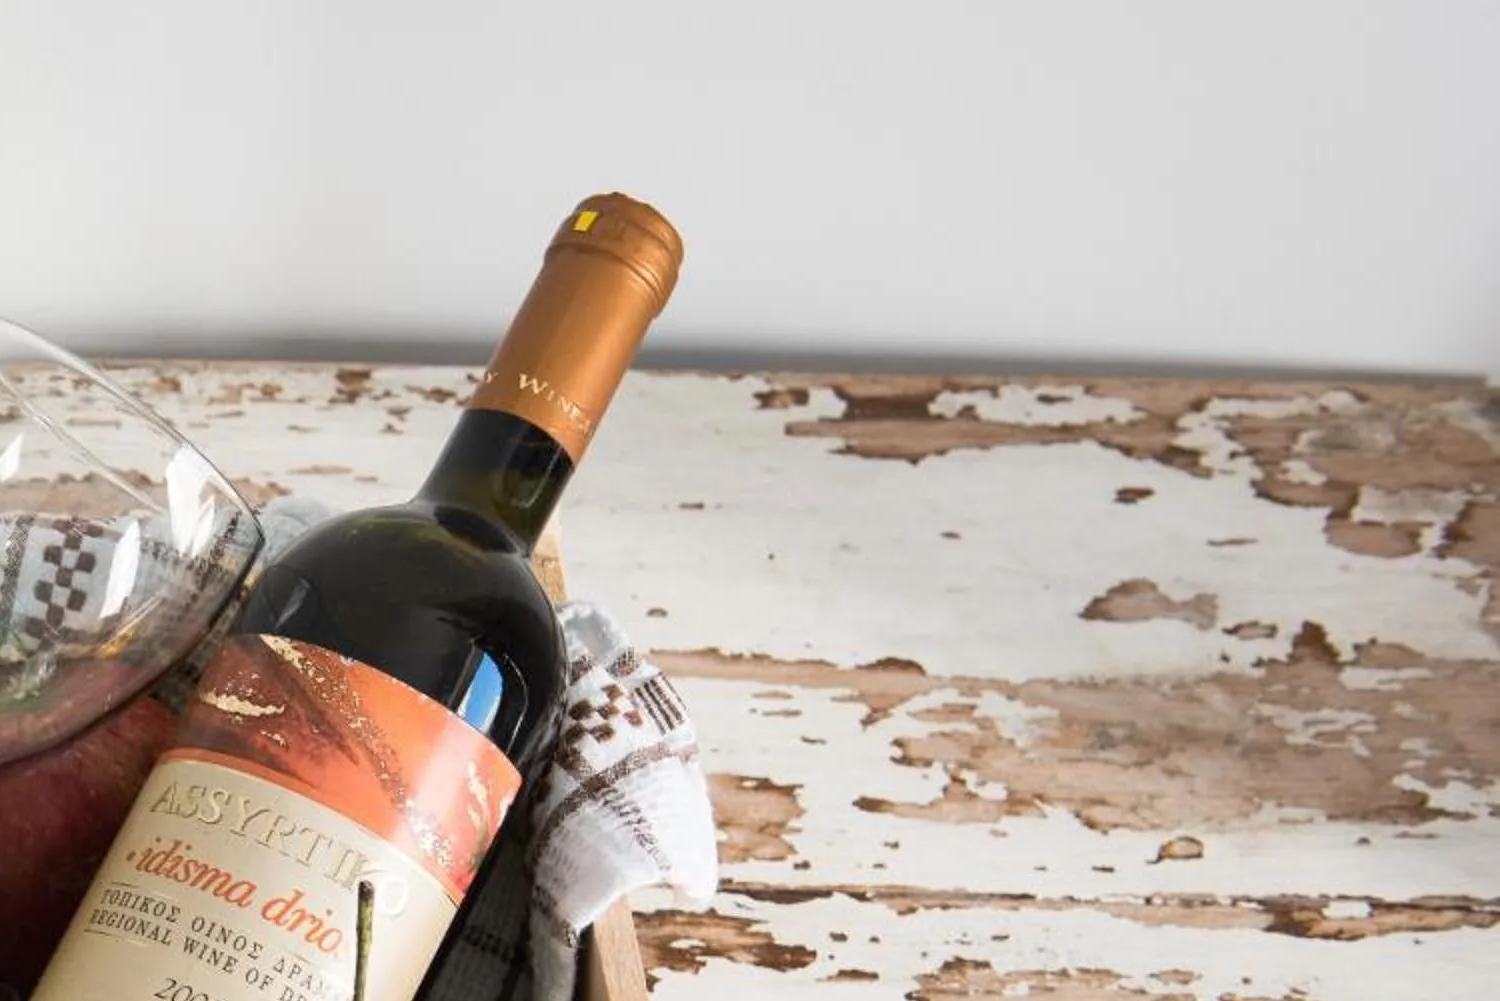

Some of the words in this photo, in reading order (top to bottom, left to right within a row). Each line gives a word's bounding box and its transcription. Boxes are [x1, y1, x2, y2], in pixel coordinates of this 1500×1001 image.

[148, 779, 409, 919] ASSYRTIKO
[89, 907, 172, 946] REGIONAL
[183, 935, 239, 974] WINE
[245, 967, 274, 991] OF
[191, 916, 263, 960] ΟΙΝΟΣ
